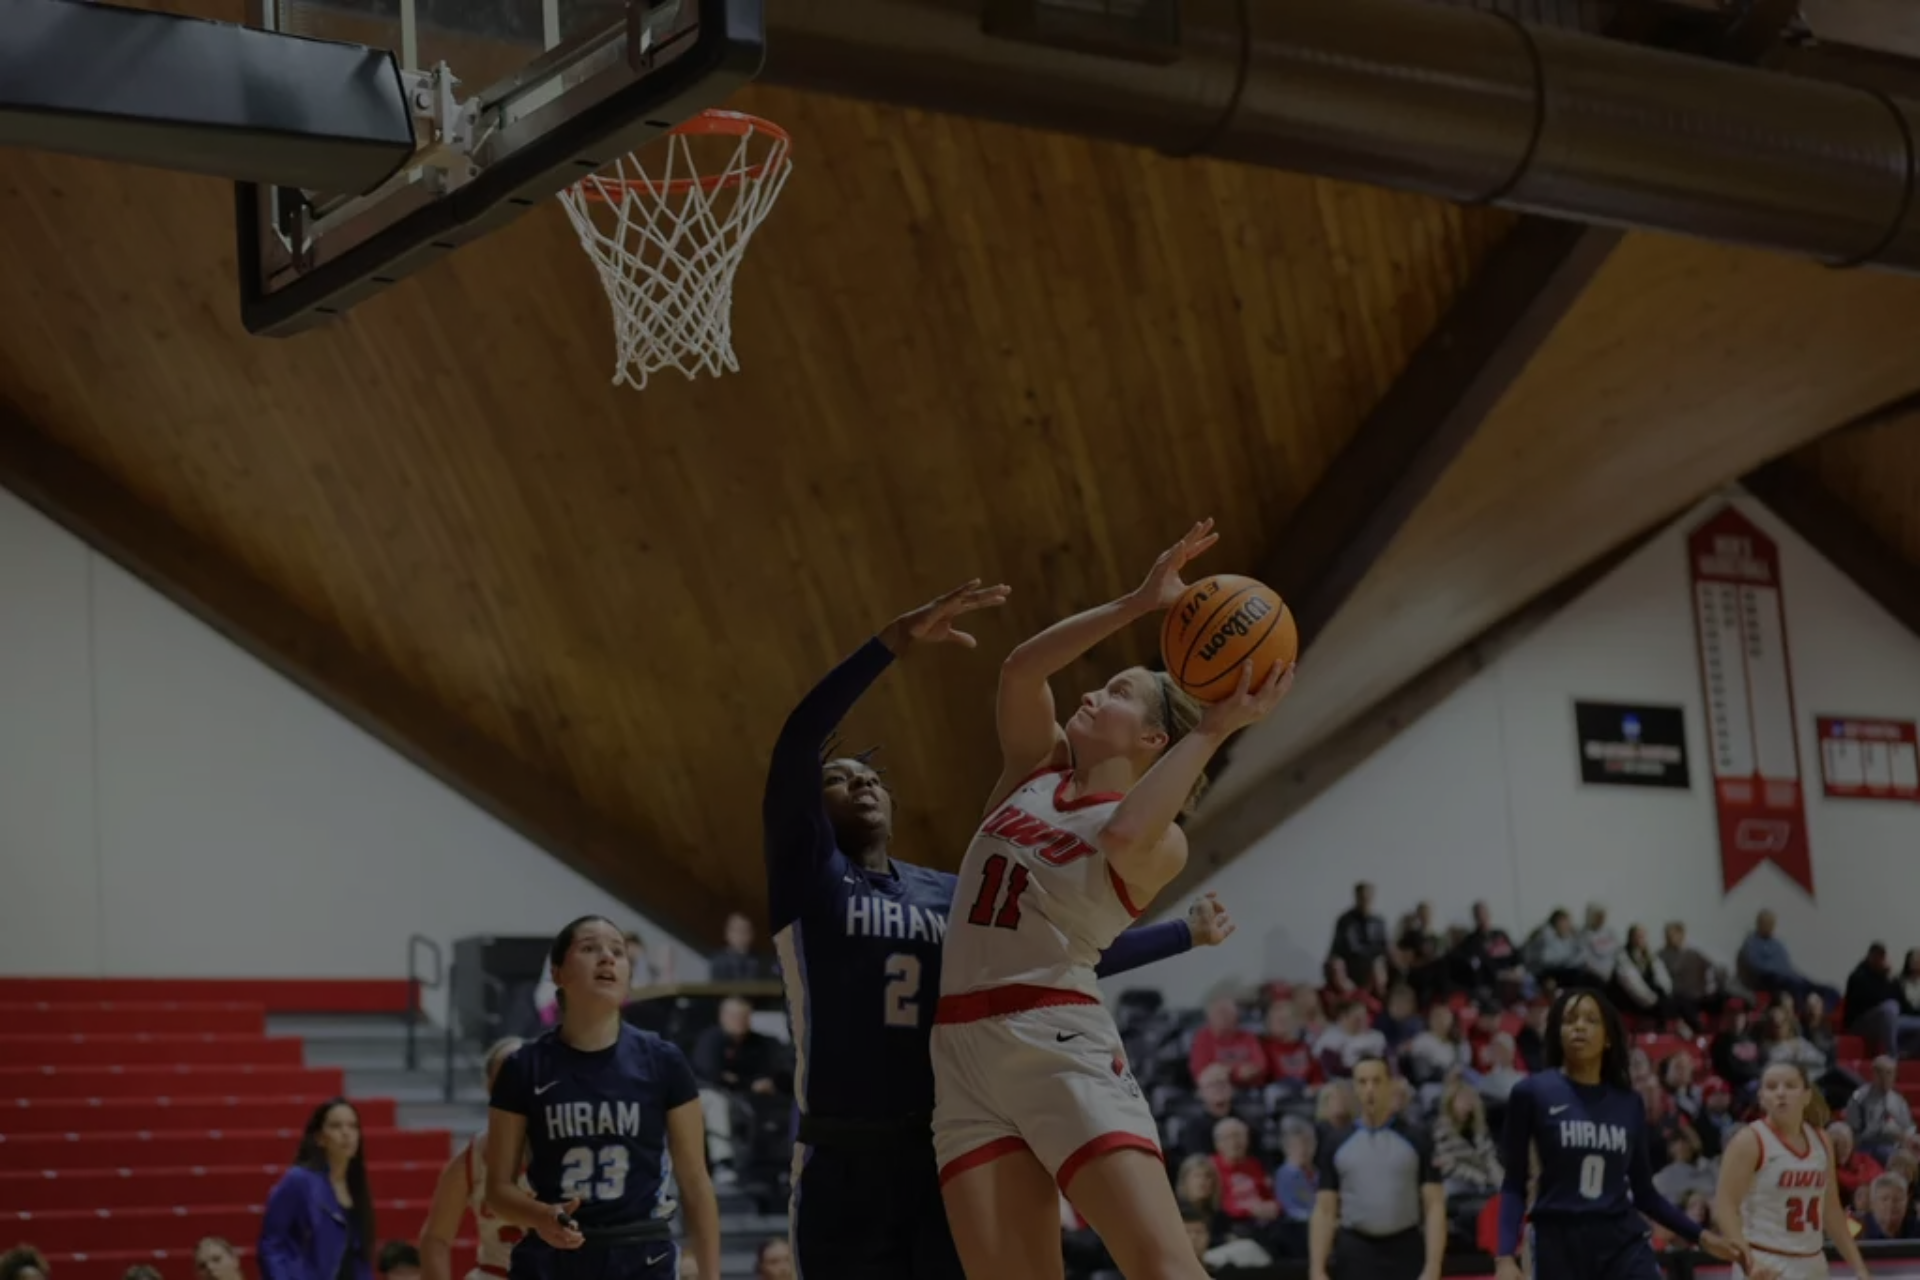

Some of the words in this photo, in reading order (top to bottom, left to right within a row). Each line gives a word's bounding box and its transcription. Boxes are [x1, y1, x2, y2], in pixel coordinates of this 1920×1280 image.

[1198, 596, 1271, 661] Wilson
[982, 805, 1097, 868] OWU
[968, 854, 1029, 931] 11
[884, 951, 922, 1028] 2
[545, 1101, 641, 1140] HIRAM
[1560, 1119, 1627, 1155] HIRAM
[560, 1144, 630, 1201] 23
[1579, 1153, 1606, 1200] 0
[1786, 1196, 1820, 1232] 24
